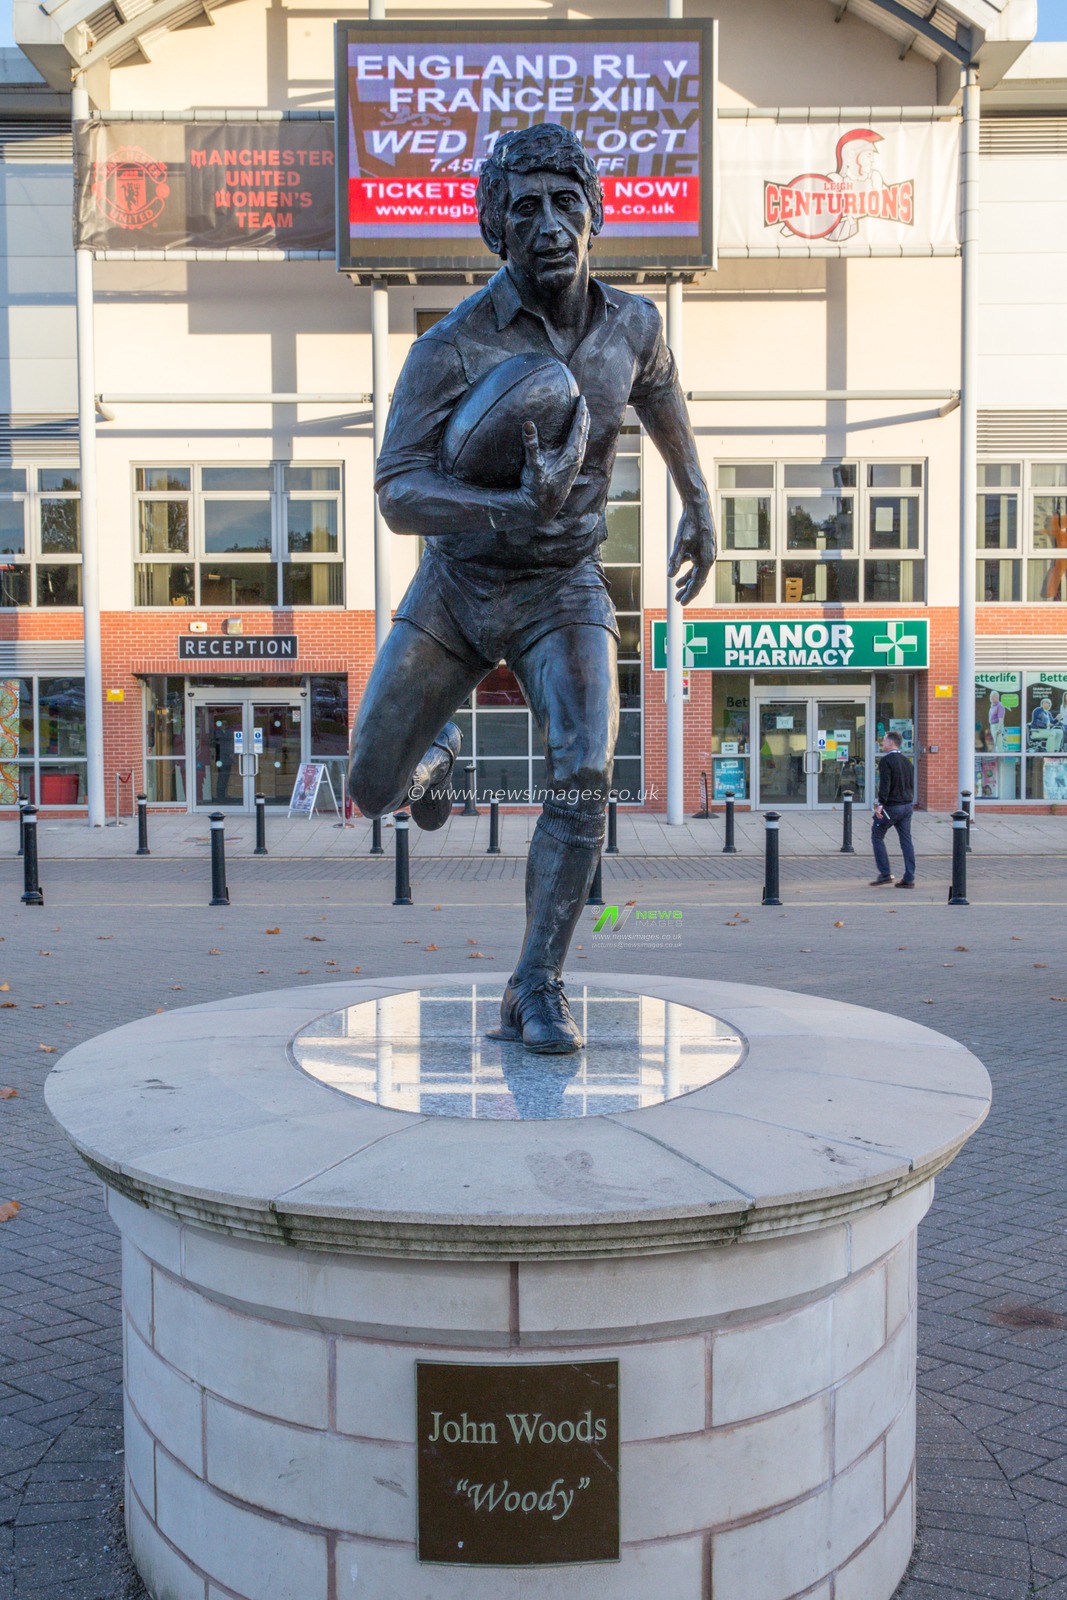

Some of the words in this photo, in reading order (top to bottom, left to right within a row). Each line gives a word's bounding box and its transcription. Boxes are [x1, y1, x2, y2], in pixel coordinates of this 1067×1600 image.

[356, 54, 577, 80] ENGLAND
[593, 54, 651, 79] RL
[663, 60, 688, 78] v
[389, 86, 574, 112] FRANCE
[589, 86, 654, 112] XIII
[372, 129, 467, 154] WED
[596, 129, 687, 153] OCT
[191, 150, 334, 168] MANCHESTER
[226, 171, 301, 186] UNITED
[823, 182, 854, 192] LEIGH
[215, 189, 313, 208] WOMEN'S
[361, 182, 477, 199] TICKETS
[615, 181, 688, 198] NOW!
[765, 182, 913, 225] CENTURIONS
[108, 208, 154, 224] UNITED
[236, 212, 293, 228] TEAM
[724, 624, 855, 649] MANOR
[185, 640, 293, 655] RECEPTION
[725, 649, 855, 666] PHARMACY
[428, 1411, 498, 1444] John
[505, 1409, 607, 1444] Woods
